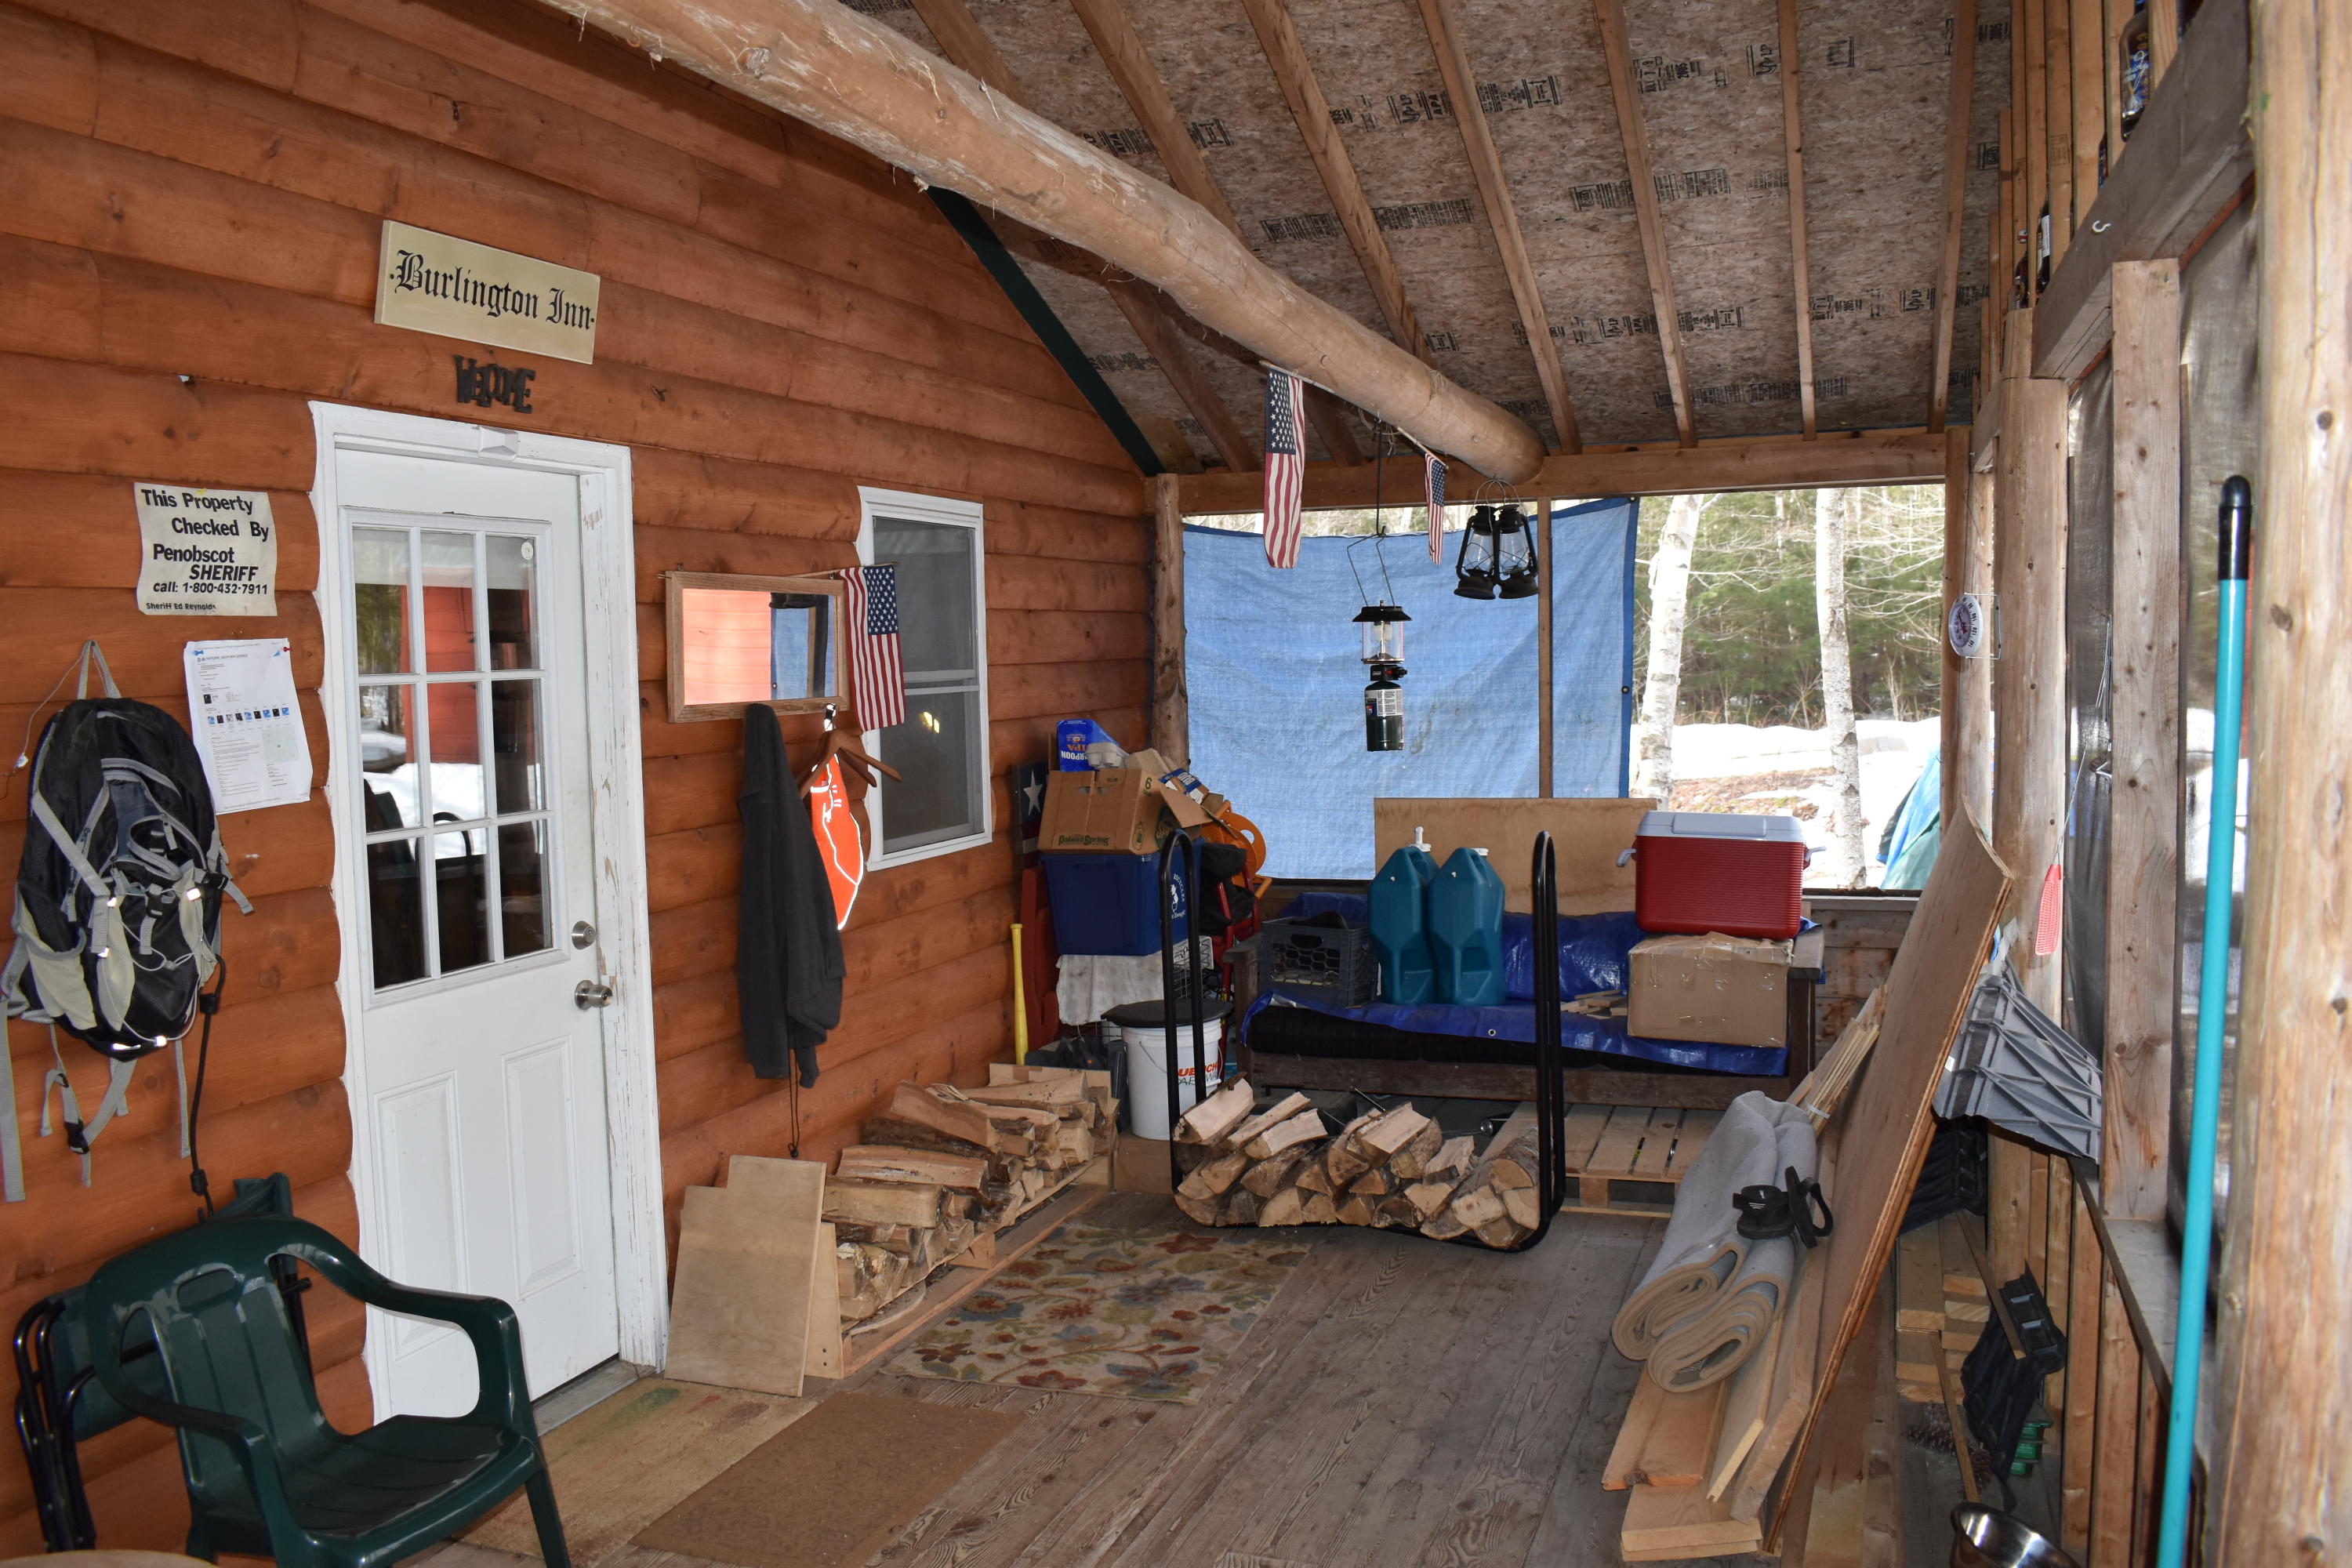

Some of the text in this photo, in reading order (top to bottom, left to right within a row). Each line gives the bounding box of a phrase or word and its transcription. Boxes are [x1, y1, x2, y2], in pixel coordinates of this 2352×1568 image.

[1430, 94, 1443, 116] APA
[394, 249, 591, 330] Burlington Inn
[1632, 317, 1643, 333] APA
[141, 489, 253, 515] This Property
[172, 517, 270, 543] Checked By
[153, 543, 235, 564] Penobscot
[189, 564, 259, 582] SHERIFF
[153, 582, 267, 594] call: 1-800-432-7911
[1061, 750, 1087, 760] RPOON
[1145, 777, 1152, 789] 6
[1178, 771, 1196, 785] BUD
[1058, 835, 1109, 846] Poland Spring
